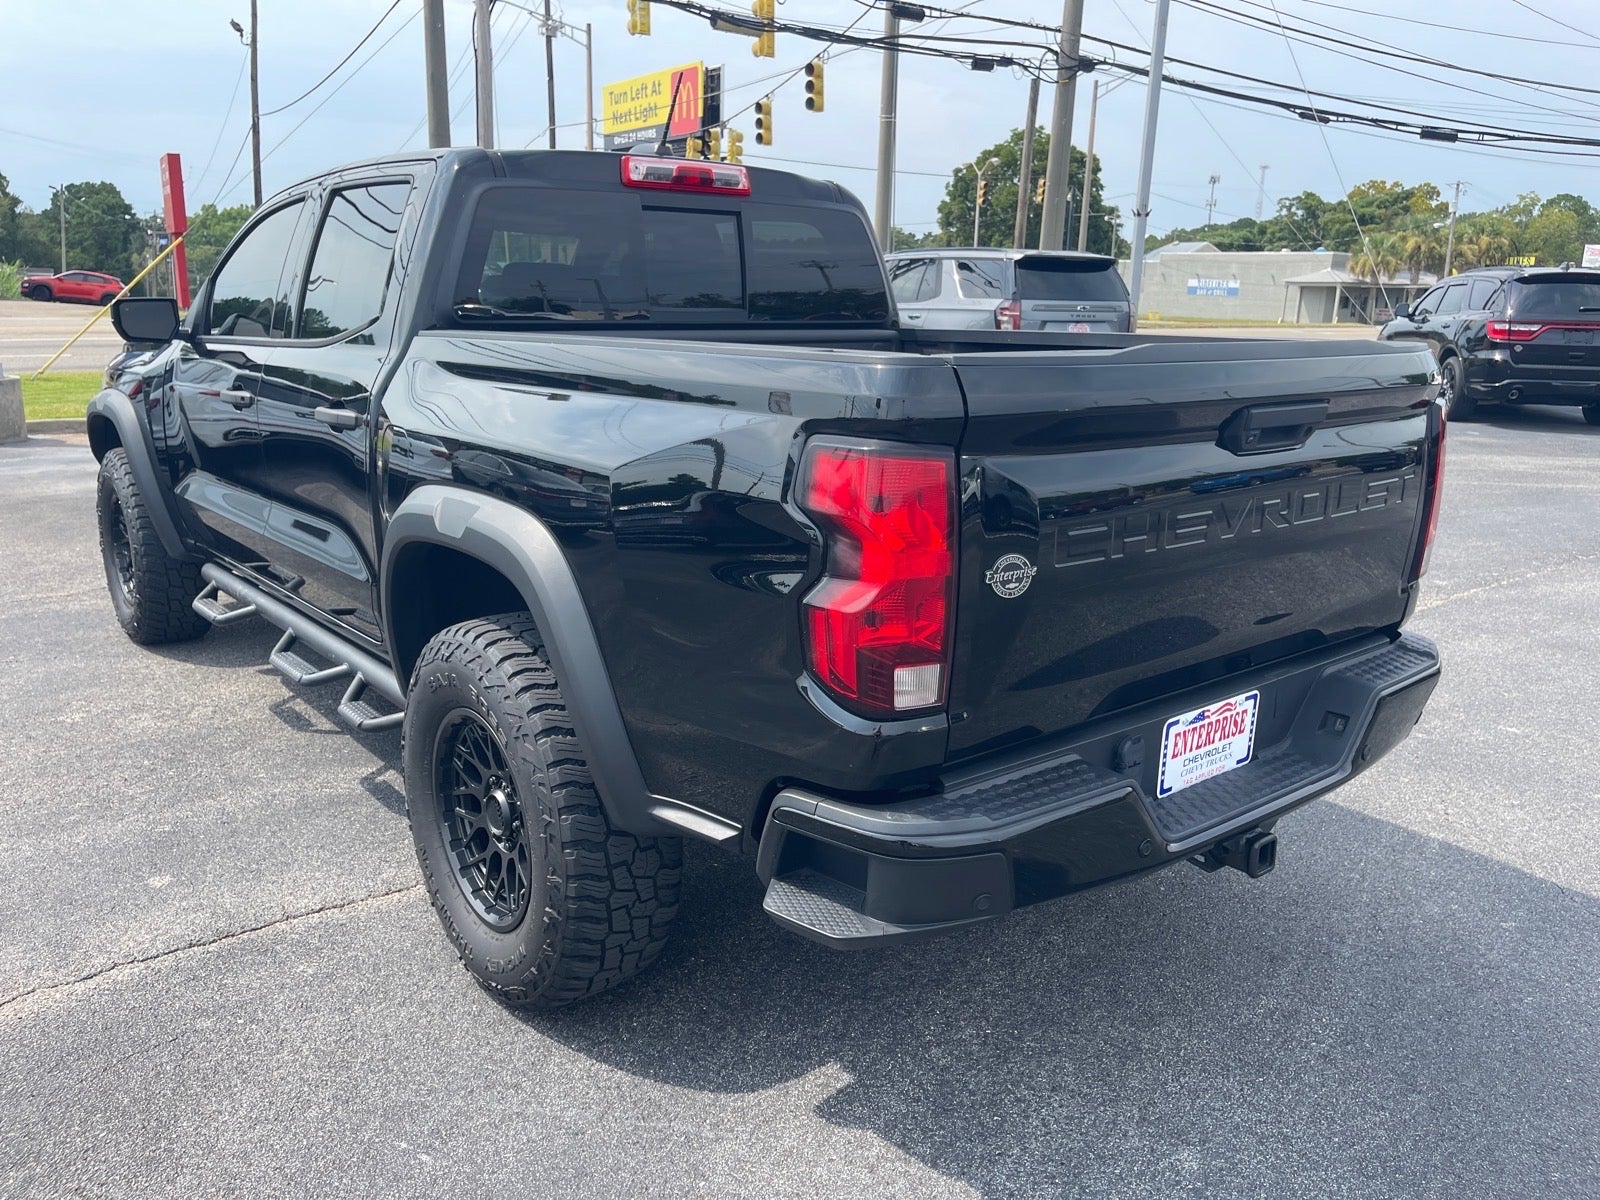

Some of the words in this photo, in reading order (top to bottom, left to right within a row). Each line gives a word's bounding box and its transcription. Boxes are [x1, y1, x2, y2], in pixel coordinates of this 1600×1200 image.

[609, 90, 628, 106] Turn
[630, 83, 648, 102] Left
[651, 80, 662, 97] At
[612, 109, 631, 125] Next
[633, 102, 658, 123] Light
[1054, 474, 1415, 567] CHEVROLET
[986, 566, 1037, 583] Enterprise
[1171, 709, 1248, 760] ENTERPRISE
[1180, 763, 1204, 777] CHEVY
[1206, 752, 1233, 768] TRUCKS
[1183, 742, 1233, 767] CHEVROLET
[1194, 769, 1215, 781] APPLIED
[1215, 765, 1225, 775] FOR
